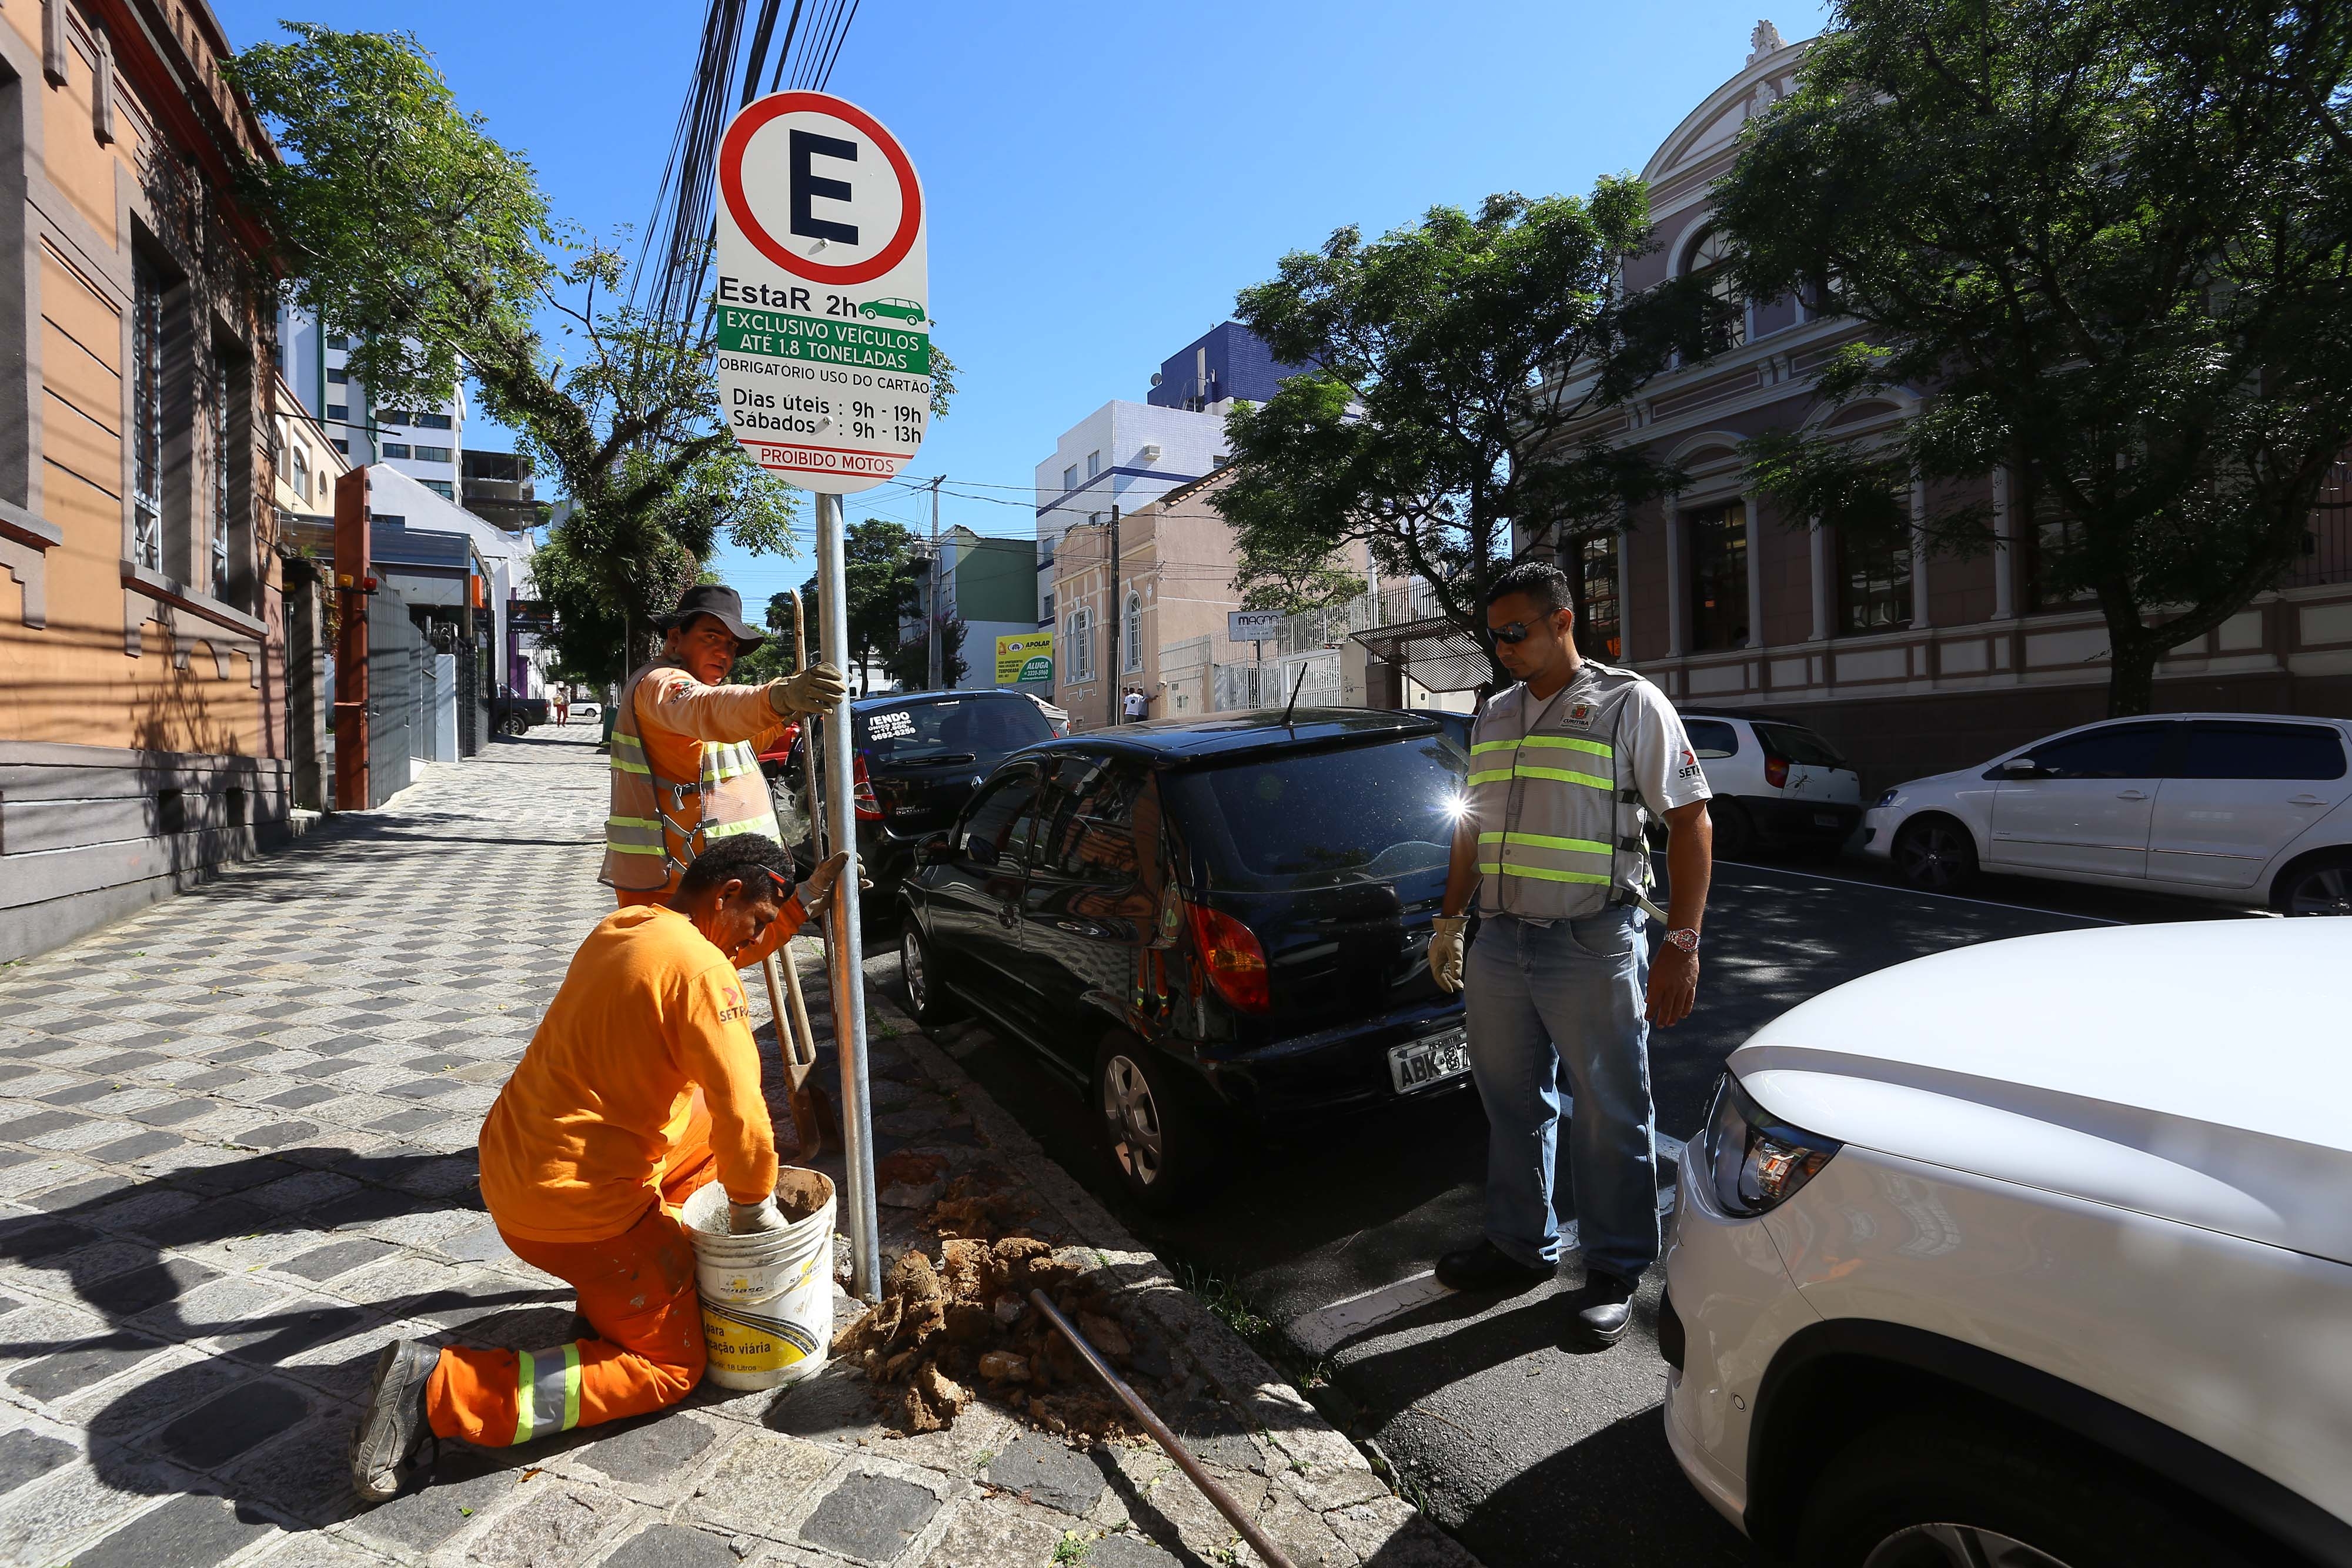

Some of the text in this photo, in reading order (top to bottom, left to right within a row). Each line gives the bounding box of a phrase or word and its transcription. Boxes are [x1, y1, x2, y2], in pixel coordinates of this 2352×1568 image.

[789, 128, 859, 246] E
[719, 276, 857, 318] EstaR 2h
[726, 310, 920, 352] EXCLUSIVO VEÍCULOS
[739, 333, 908, 369] ATÉ 1,8 TONELADAS
[719, 357, 930, 394] OBRIGATÓRIO USO DO CARTÃO
[733, 388, 776, 409] Dias
[783, 394, 830, 414] úteis
[852, 401, 875, 419] 9h
[894, 405, 922, 424] 19h
[733, 410, 816, 434] Sábados
[853, 422, 875, 439] 9h
[894, 425, 922, 443] 13h
[761, 448, 894, 473] PROIBIDO MOTOS
[1027, 661, 1048, 670] ALUGA
[706, 1322, 725, 1337] para
[739, 1342, 771, 1355] viária
